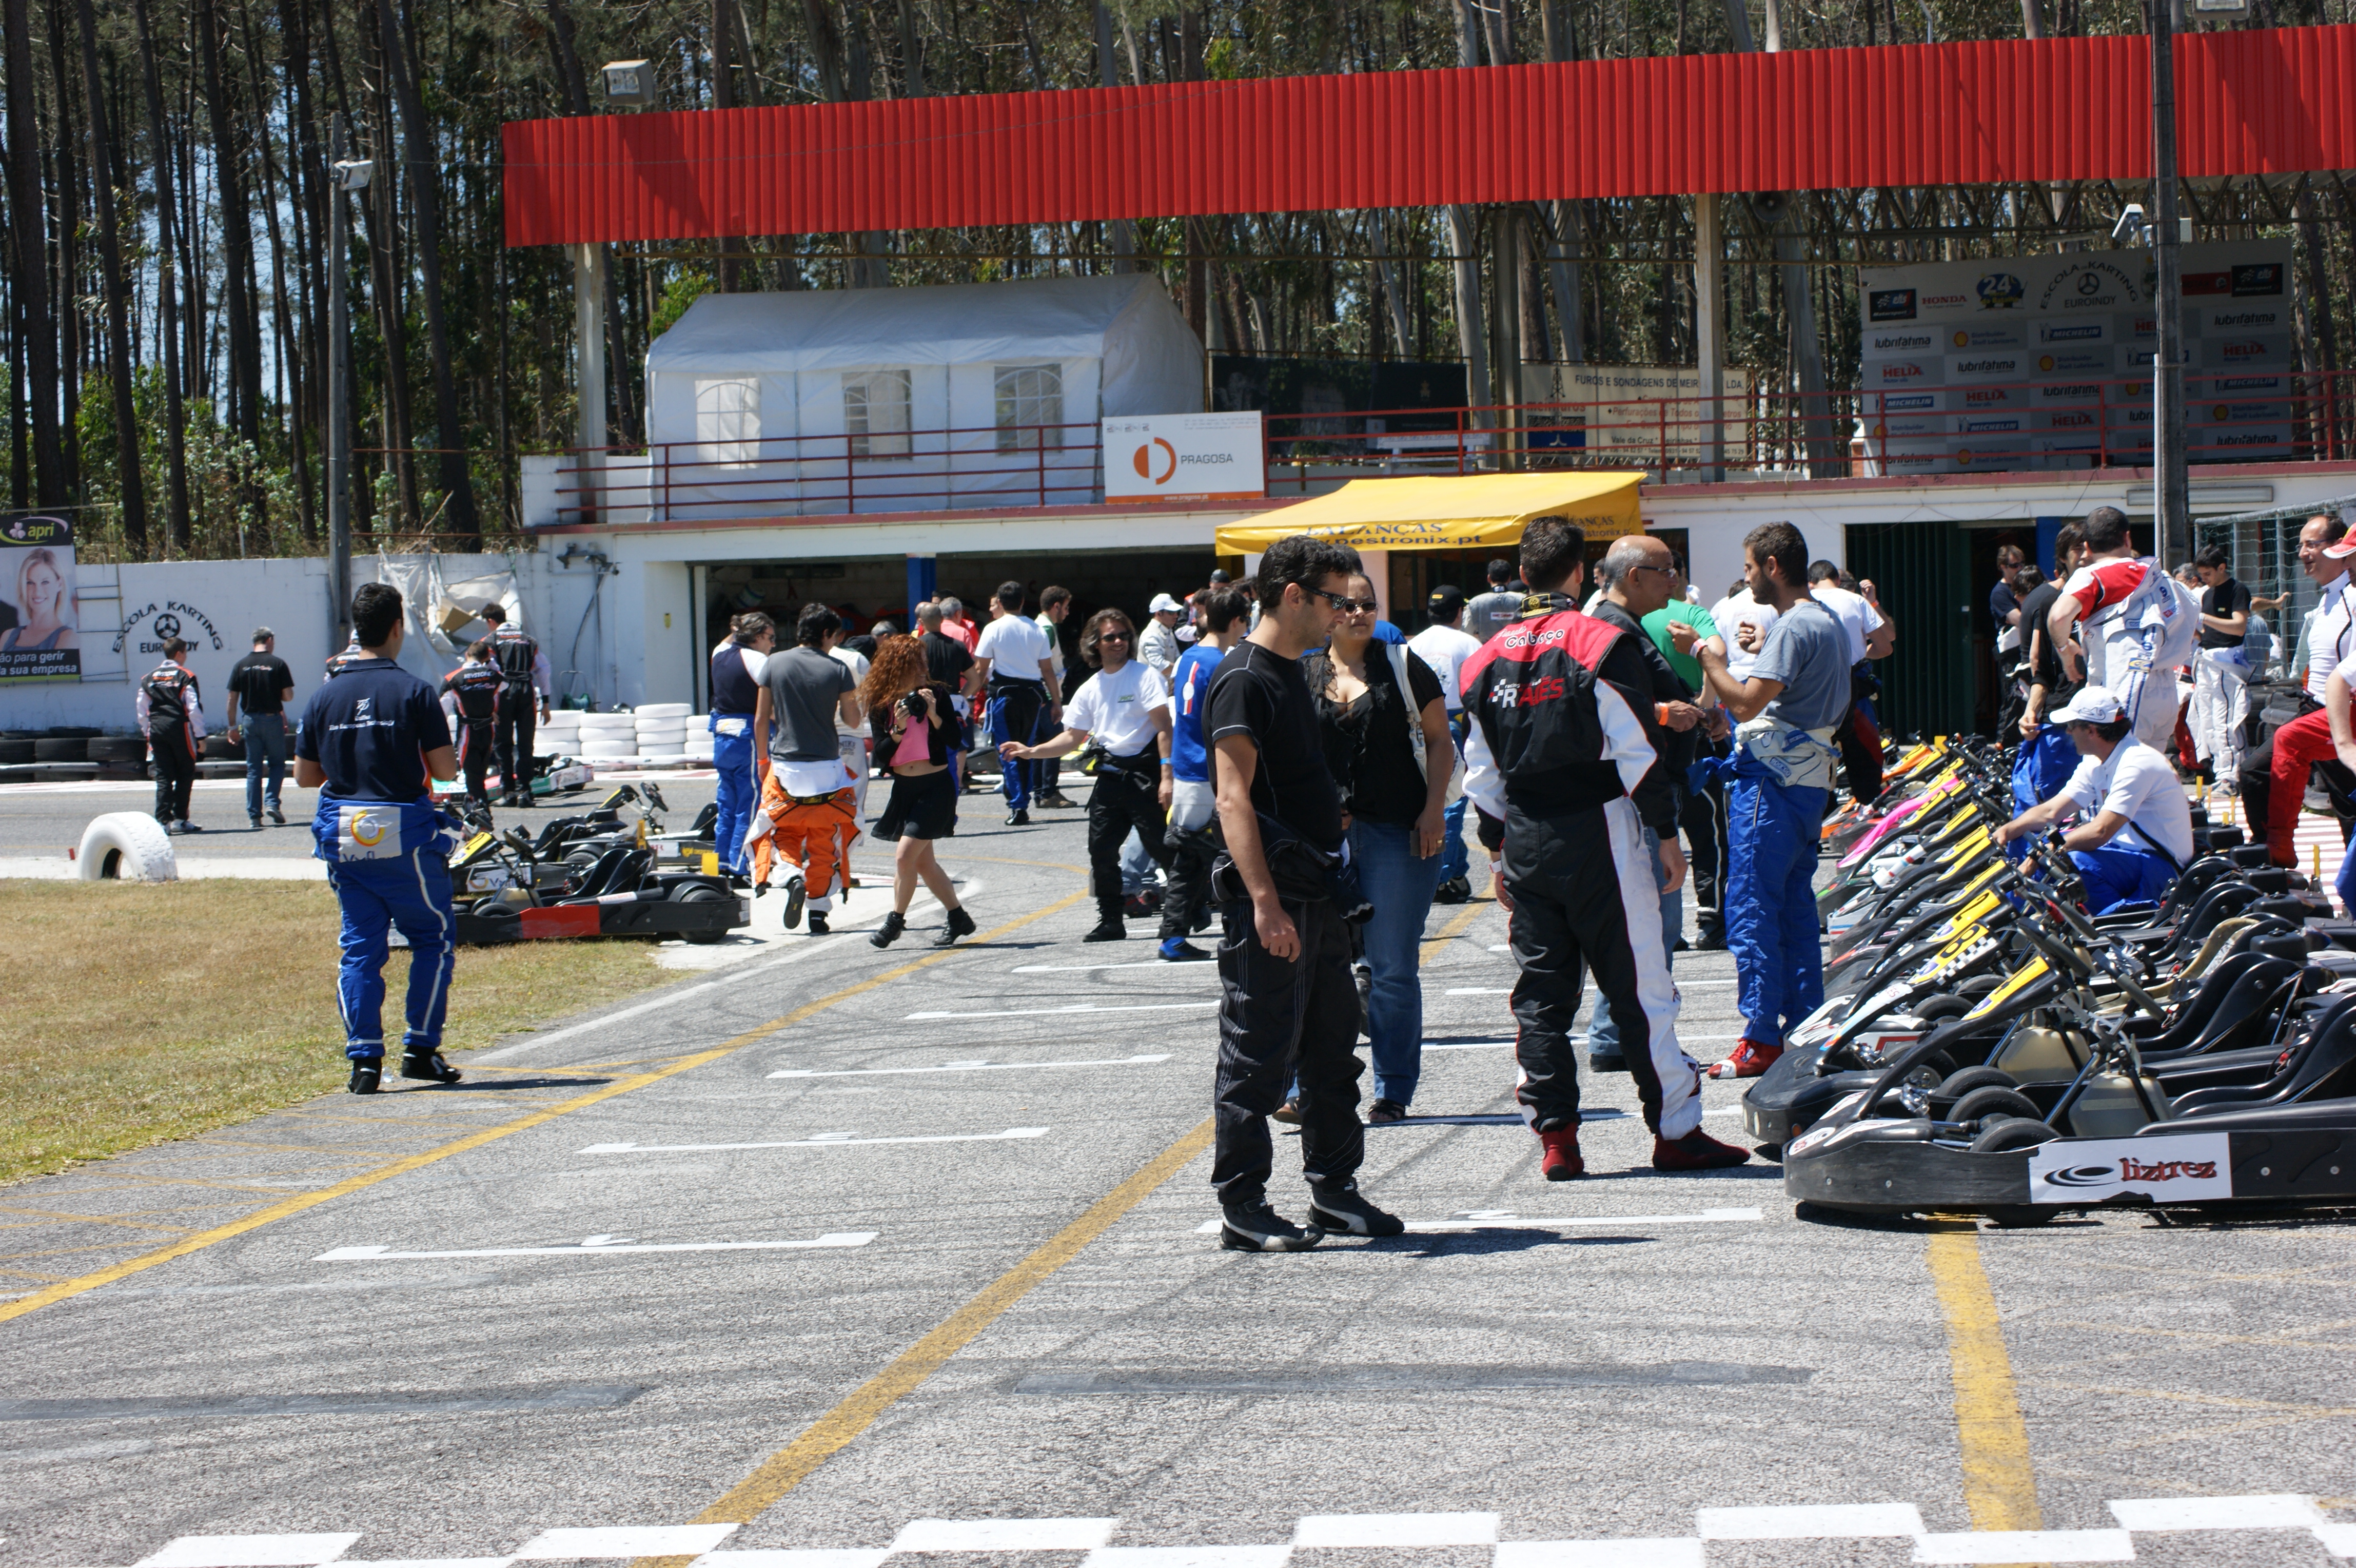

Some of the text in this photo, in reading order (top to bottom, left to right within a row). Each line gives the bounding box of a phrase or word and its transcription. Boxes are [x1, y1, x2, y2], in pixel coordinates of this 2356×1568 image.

[1982, 275, 2011, 296] 24
[2040, 264, 2079, 309] ESCOLA
[2088, 261, 2139, 302] KARTING
[1921, 295, 1967, 305] HONDA
[2064, 295, 2117, 308] EUROINDY
[2052, 327, 2100, 338] MICHELIN
[2223, 342, 2266, 356] HELIX
[1882, 366, 1922, 378] HELIX
[1576, 375, 1603, 385] FUROS
[1606, 377, 1611, 386] E
[1614, 377, 1664, 387] SONDAGENS
[1666, 379, 1677, 387] DE
[1726, 381, 1744, 389] LDA.
[1886, 397, 1933, 407] MICHELIN
[1966, 390, 2007, 402] HELIX
[1613, 407, 1657, 418] Perfurações
[1671, 408, 1693, 418] Todos
[1970, 421, 2018, 432] MICHELIN
[2052, 415, 2093, 427] HELIX
[1181, 454, 1233, 464] PRAGOSA
[28, 523, 54, 540] apri
[112, 601, 224, 654] ESCOLA KARTING
[1504, 629, 1565, 649] Cabeço
[14, 653, 36, 664] para
[40, 650, 65, 663] gerir
[10, 665, 29, 675] sua
[32, 664, 77, 676] empresa
[466, 833, 485, 850] 2
[1955, 892, 1990, 922] 2
[1939, 925, 1980, 958] 8
[2118, 1157, 2217, 1182] liztrez
